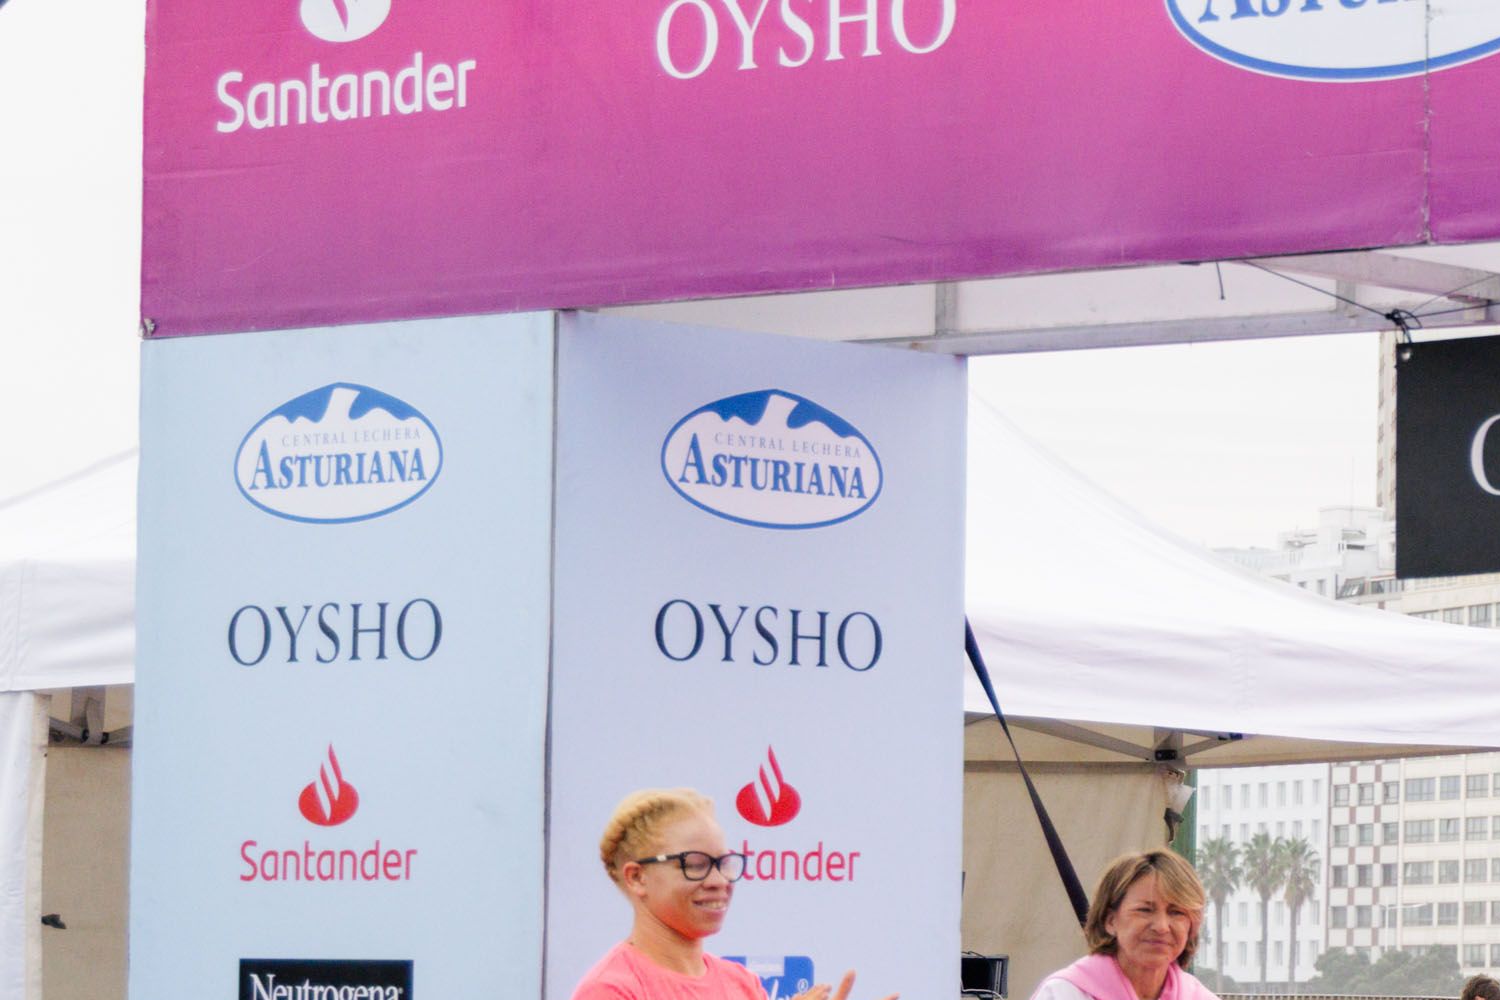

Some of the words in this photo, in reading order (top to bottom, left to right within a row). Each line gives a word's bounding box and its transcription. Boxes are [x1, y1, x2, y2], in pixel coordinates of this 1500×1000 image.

[656, 0, 957, 80] OYSHO
[215, 51, 476, 134] Santander
[248, 438, 428, 491] ASTURIANA
[281, 431, 347, 448] CENTRAL
[353, 427, 422, 444] LECHERA
[677, 432, 868, 500] ASTURIANA
[714, 431, 785, 451] CENTRAL
[792, 439, 862, 459] LECHERA
[227, 597, 444, 667] OYSHO
[654, 598, 884, 673] OYSHO
[239, 838, 418, 882] Santander
[742, 838, 861, 882] tander
